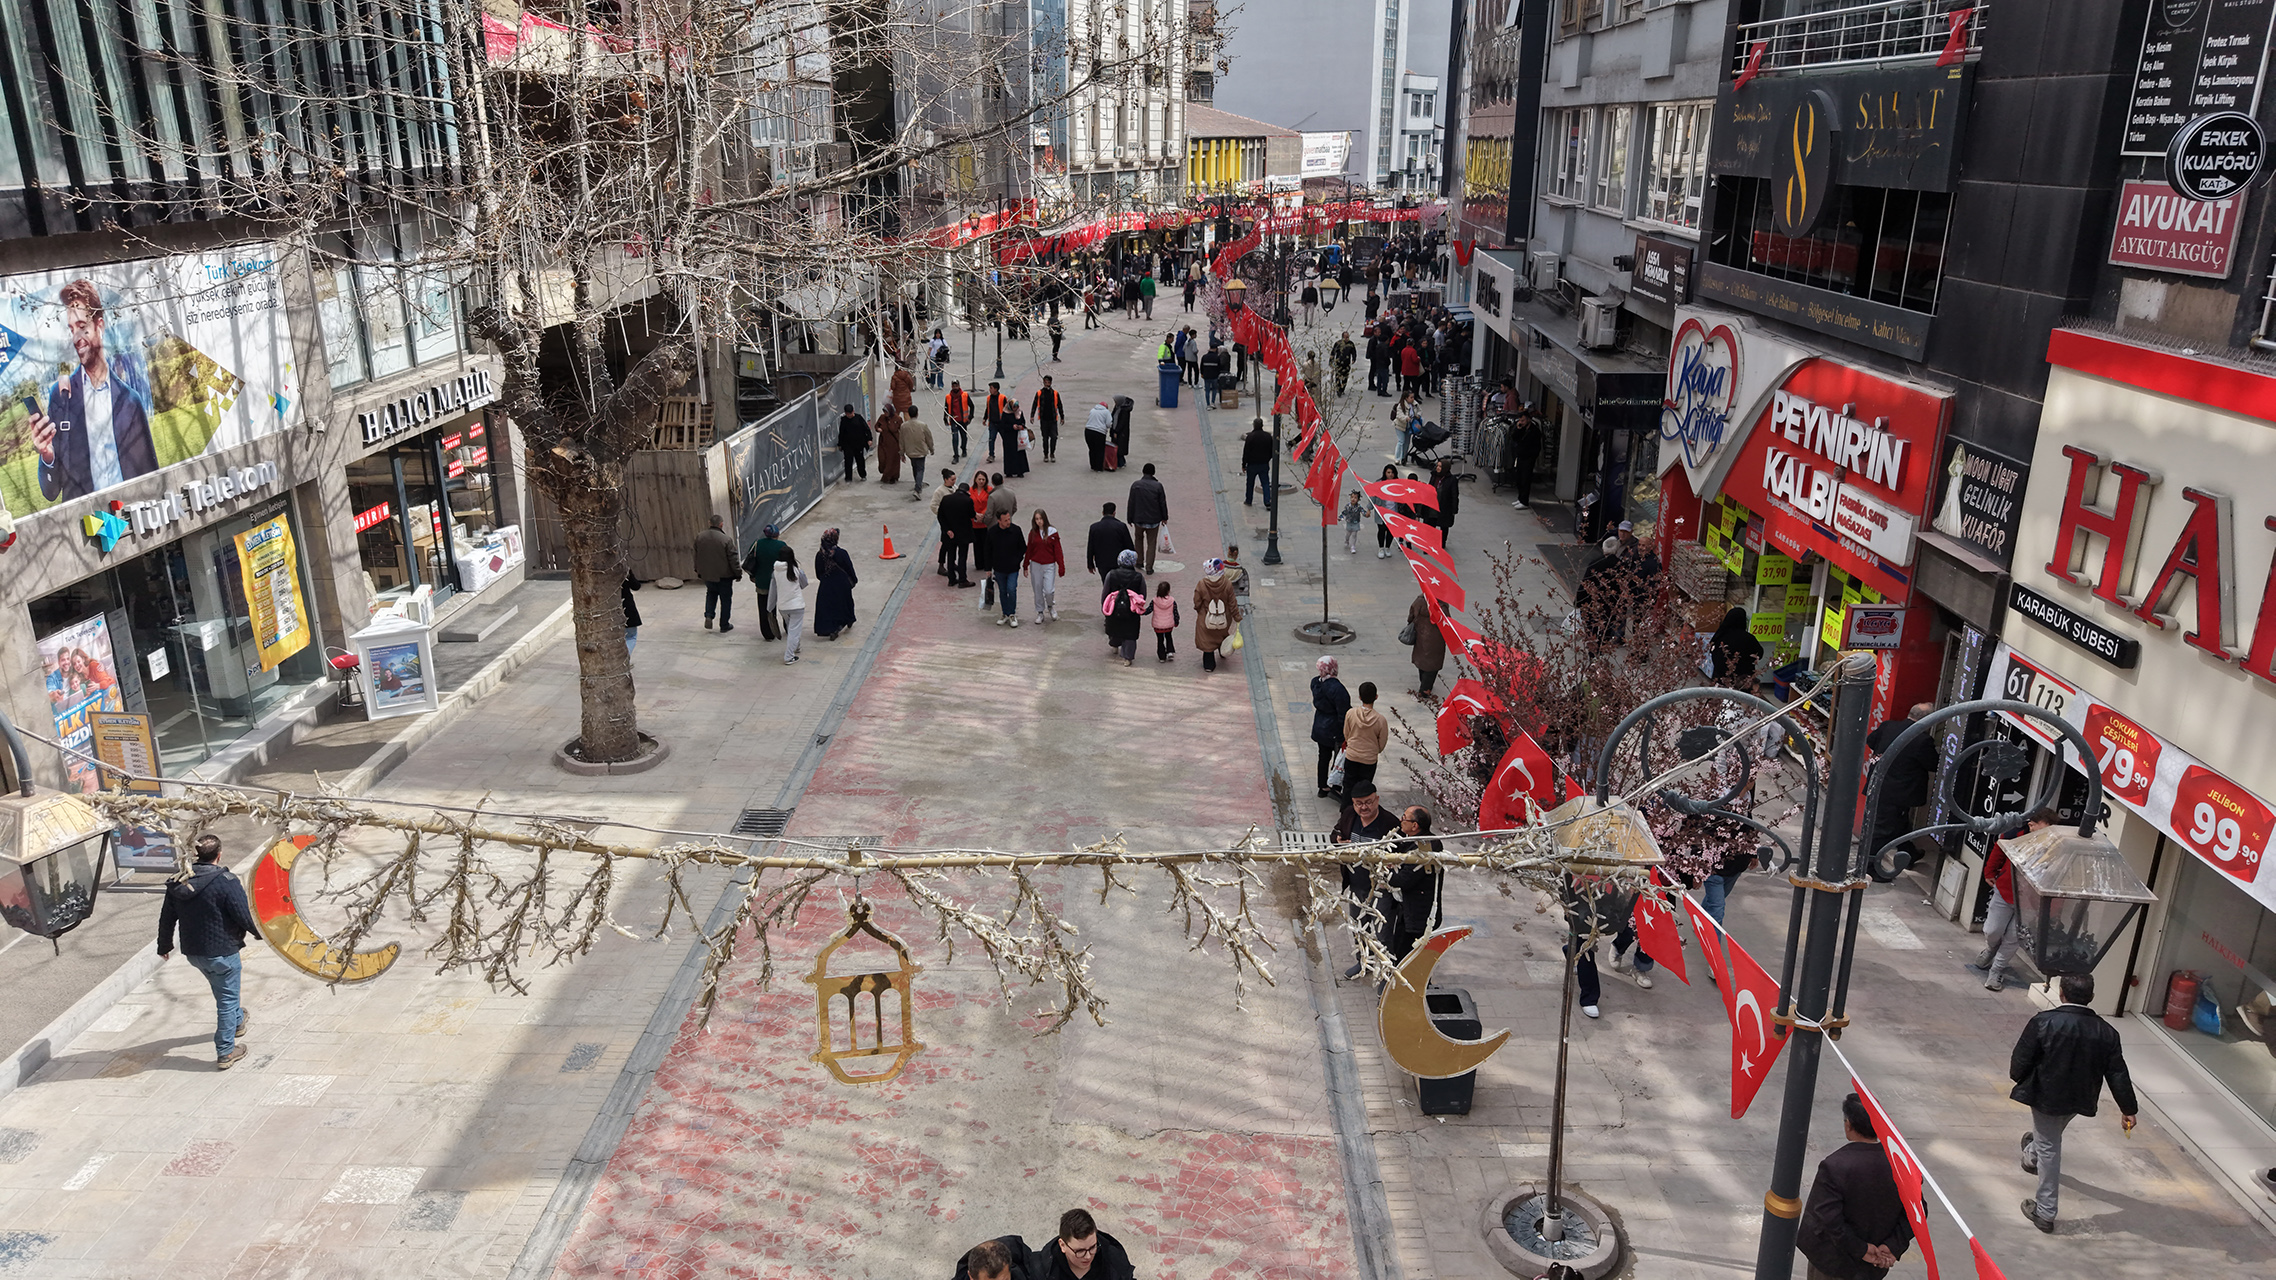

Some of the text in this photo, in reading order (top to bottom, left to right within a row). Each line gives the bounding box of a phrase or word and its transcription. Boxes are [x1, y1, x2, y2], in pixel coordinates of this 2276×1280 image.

[2156, 42, 2172, 52] Kesim
[2206, 34, 2251, 48] Protez Tırnak
[2202, 54, 2239, 69] İpek Kirpik
[2198, 74, 2255, 89] Kaş Laminasyonu
[2194, 94, 2237, 107] Kirpik Lifting
[2200, 130, 2252, 147] ERKEK
[2184, 151, 2258, 171] KUAFÖRÜ
[2200, 179, 2229, 189] KAT:1
[2122, 194, 2233, 235] AVUKAT
[2118, 236, 2168, 258] AYKUT
[2166, 240, 2225, 270] AKGÜÇ
[205, 259, 275, 280] Türk Telekom
[1807, 301, 1835, 324] Bölgesel
[1675, 341, 1727, 409] Kaya
[364, 366, 493, 443] HALICI MAHİR
[1599, 397, 1662, 406] blue diamond
[1770, 389, 1904, 492] PEYNİR'İN
[1963, 454, 1992, 483] MOON
[124, 461, 278, 534] Türk Telekom
[1963, 483, 2013, 523] GELİNLİK
[250, 508, 268, 523] Eymen
[354, 504, 389, 531] NDİRİM
[1840, 493, 1889, 532] FABRİKA SATIŞ
[1836, 512, 1872, 543] MAĞAZASI
[1961, 513, 2006, 555] KUAFÖR
[1774, 530, 1801, 552] KARABÜK
[1839, 535, 1880, 568] 444 00 74
[1762, 567, 1787, 579] 37,90
[1752, 624, 1783, 635] 289,00
[1824, 622, 1840, 642] 990,00
[2016, 590, 2119, 659] KARABÜK ŞUBESİ
[2007, 667, 2065, 718] 61 113
[60, 723, 93, 750] BİZD
[2103, 725, 2138, 753] ÇEŞİTLERİ
[2110, 716, 2139, 740] LOKUM
[2207, 789, 2246, 818] JELİBON
